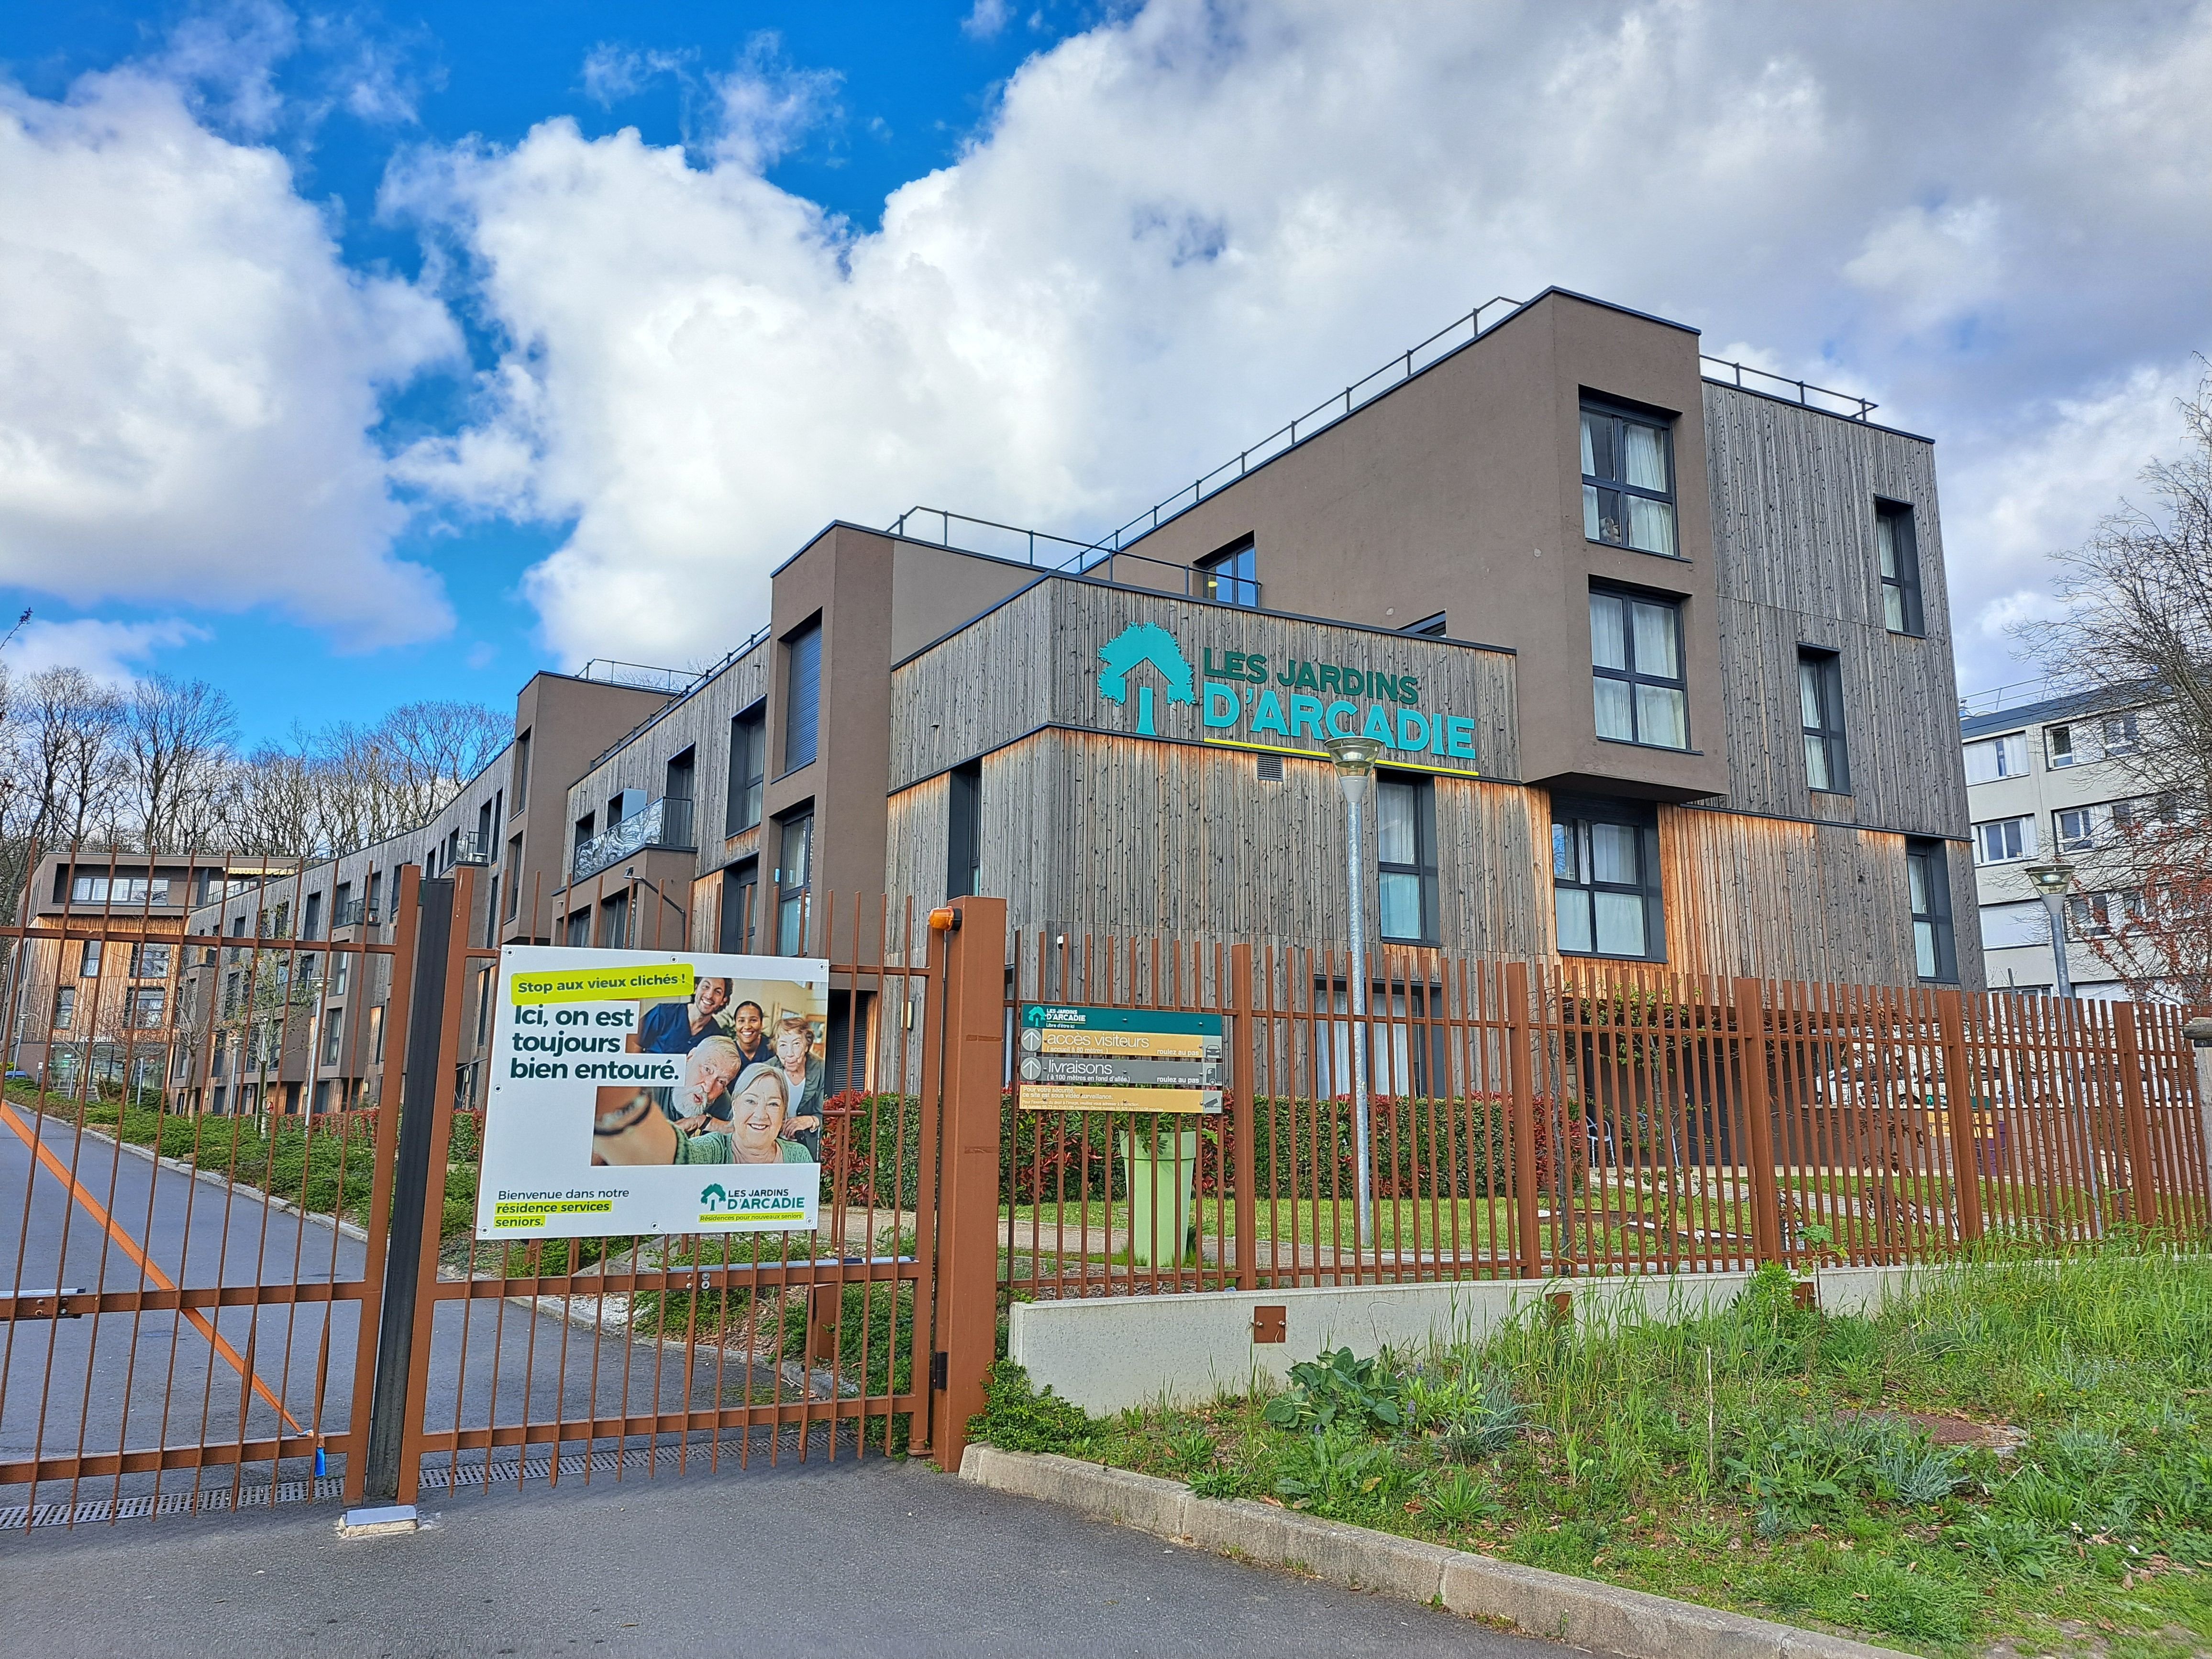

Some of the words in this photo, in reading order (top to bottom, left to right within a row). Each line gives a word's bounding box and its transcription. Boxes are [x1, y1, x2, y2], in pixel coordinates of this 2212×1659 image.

[1204, 647, 1267, 684] LES
[1277, 659, 1418, 705] JARDINS
[1204, 682, 1476, 760] D'ARCADIE
[518, 982, 552, 994] Stop
[557, 981, 584, 990] aux
[588, 977, 626, 988] vieux
[630, 974, 678, 986] clichés
[515, 1004, 548, 1027] Ici,
[555, 1010, 589, 1026] on
[596, 1009, 634, 1027] est
[1046, 1013, 1086, 1022] D'ARCADIE
[512, 1030, 620, 1057] toujours
[1047, 1032, 1091, 1045] accès
[1094, 1033, 1149, 1049] visiteurs
[510, 1057, 568, 1078] bien
[575, 1059, 679, 1080] entouré.
[1049, 1059, 1112, 1074] livraisons
[498, 1190, 563, 1200] Bienvenue
[566, 1189, 595, 1198] dans
[598, 1190, 629, 1198] notre
[497, 1203, 557, 1214] résidence
[561, 1202, 610, 1212] services
[727, 1197, 805, 1210] D'ARCADIE
[495, 1216, 543, 1227] seniors.
